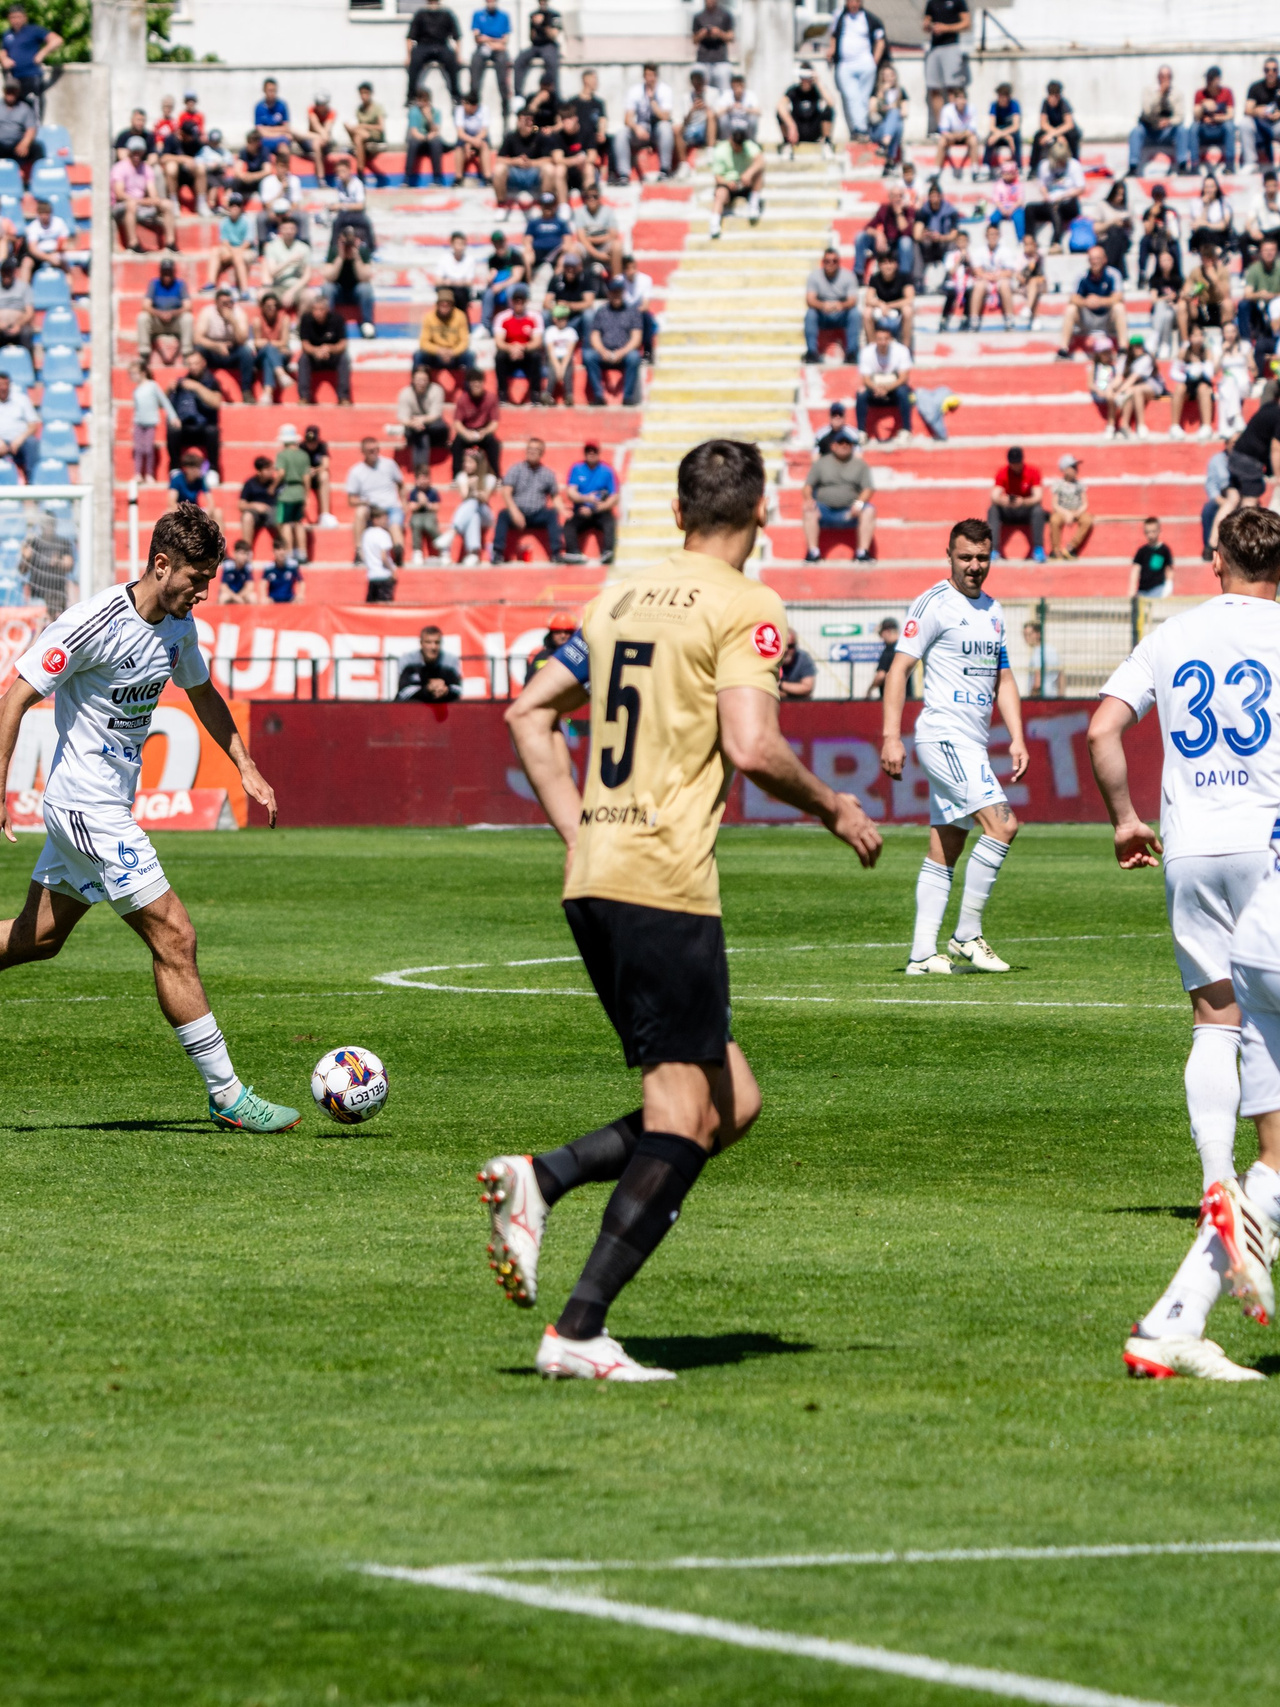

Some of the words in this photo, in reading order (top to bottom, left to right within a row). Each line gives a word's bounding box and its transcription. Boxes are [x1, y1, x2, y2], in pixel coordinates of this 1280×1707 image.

[639, 587, 701, 608] HILS
[962, 640, 1000, 656] UNIBE
[601, 641, 656, 788] 5
[1170, 659, 1272, 759] 33
[1195, 770, 1249, 787] DAVID
[117, 841, 139, 869] 6
[137, 861, 158, 876] Vestra
[350, 1081, 385, 1107] SELECT
